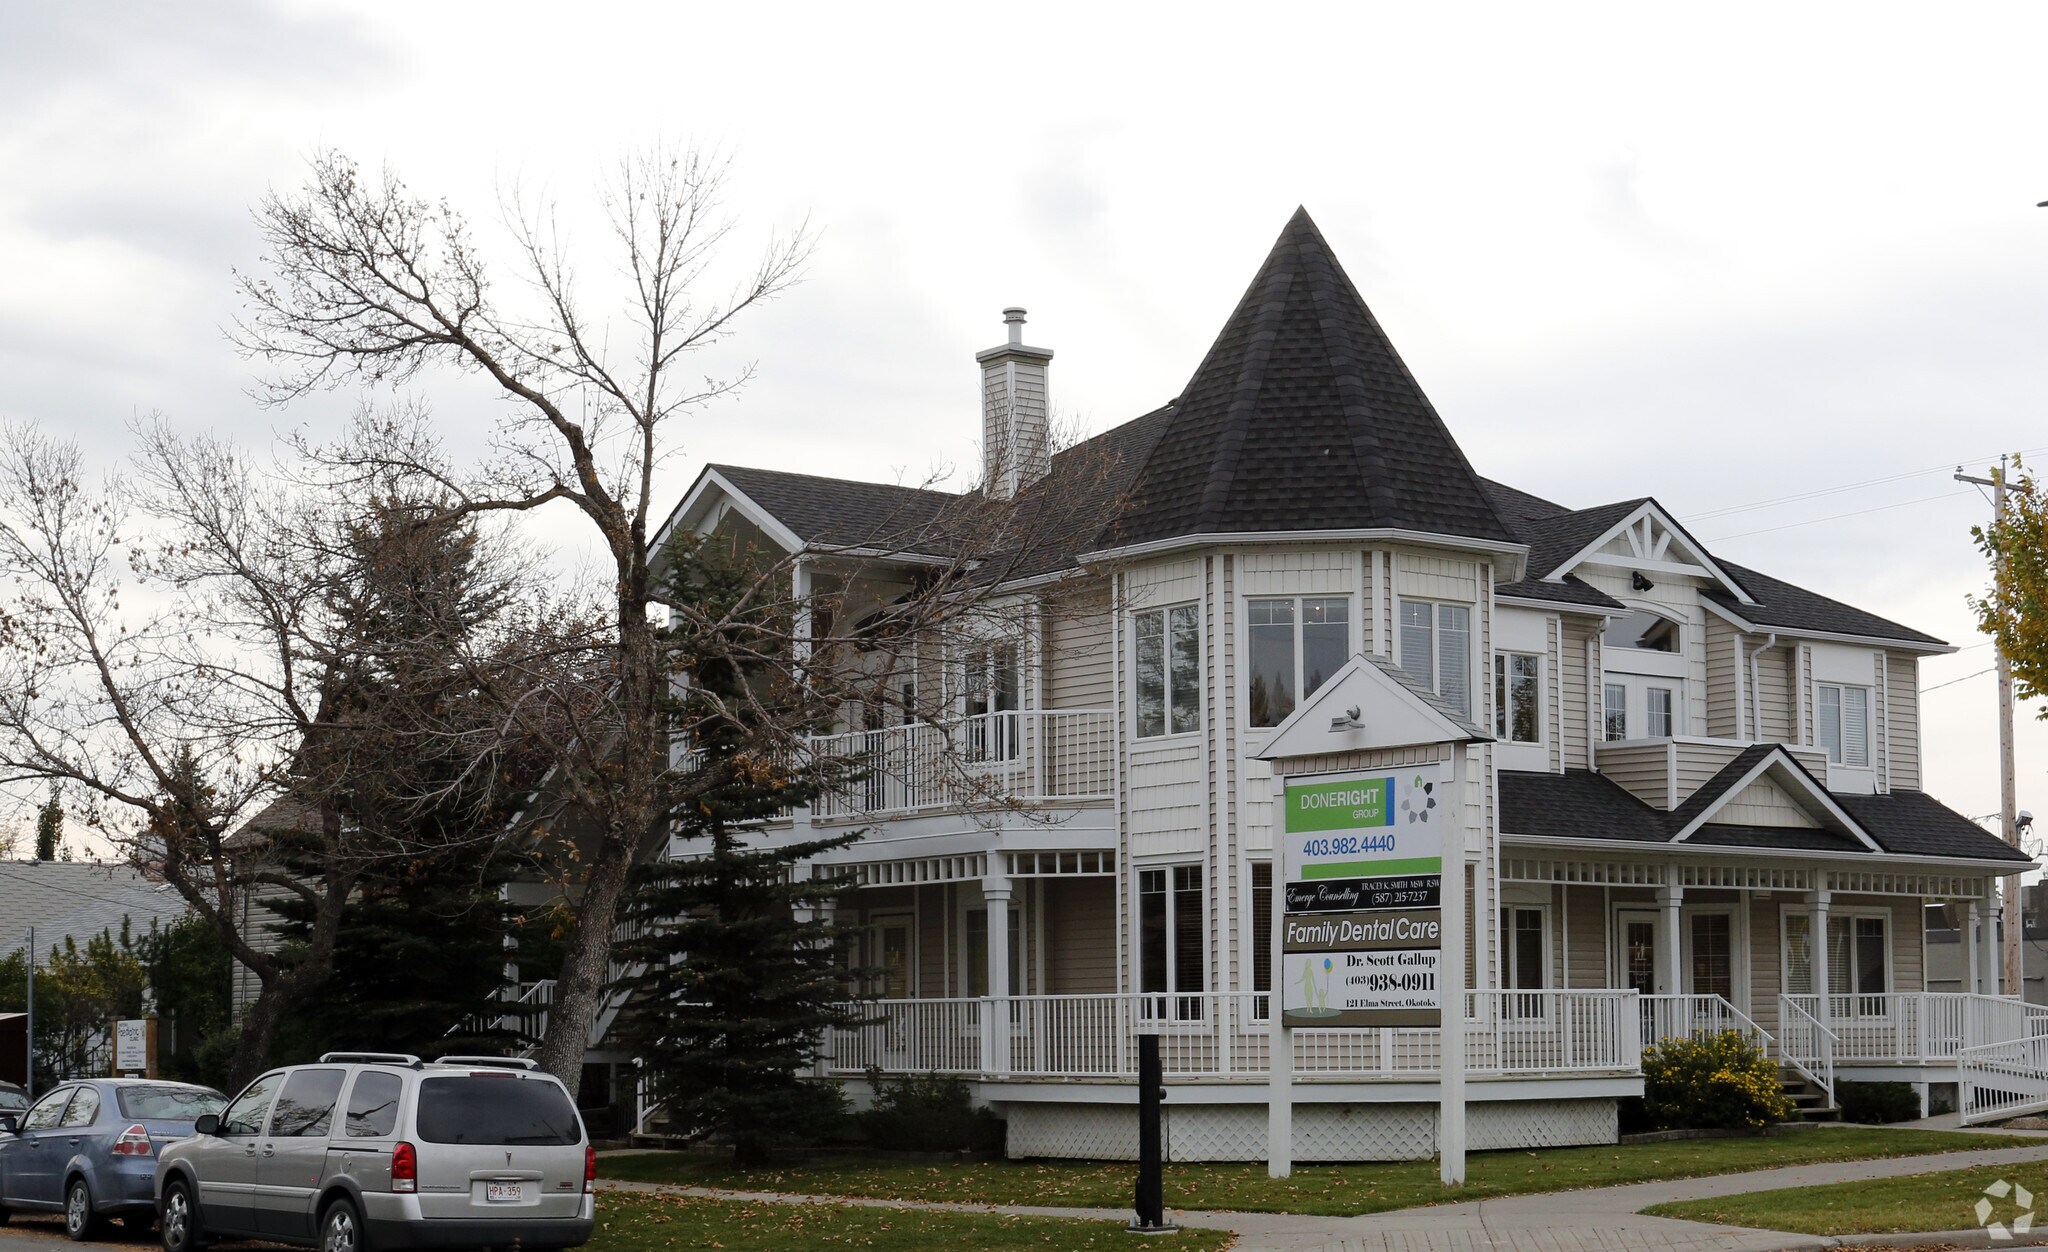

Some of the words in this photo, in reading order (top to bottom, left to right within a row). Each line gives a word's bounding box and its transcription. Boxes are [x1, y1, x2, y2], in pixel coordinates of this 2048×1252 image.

[1300, 788, 1380, 810] DONERIGHT
[1352, 808, 1380, 820] GROUP
[1303, 834, 1396, 856] 403.982.4440
[1361, 882, 1383, 891] TRACEY
[1391, 880, 1408, 889] SMITH
[1410, 880, 1424, 888] MSW
[1371, 892, 1393, 905] (587)
[1394, 890, 1428, 903] 215-7237
[1287, 921, 1339, 947] Family
[1340, 918, 1395, 942] Dental
[1396, 917, 1439, 940] Care
[1346, 954, 1364, 967] Dr.
[1366, 954, 1395, 967] Scott
[1397, 952, 1436, 969] Gallup
[1346, 999, 1358, 1008] 121
[1360, 999, 1379, 1008] Elma
[1405, 998, 1436, 1007] Okotoks
[489, 1186, 521, 1196] HPA-359
